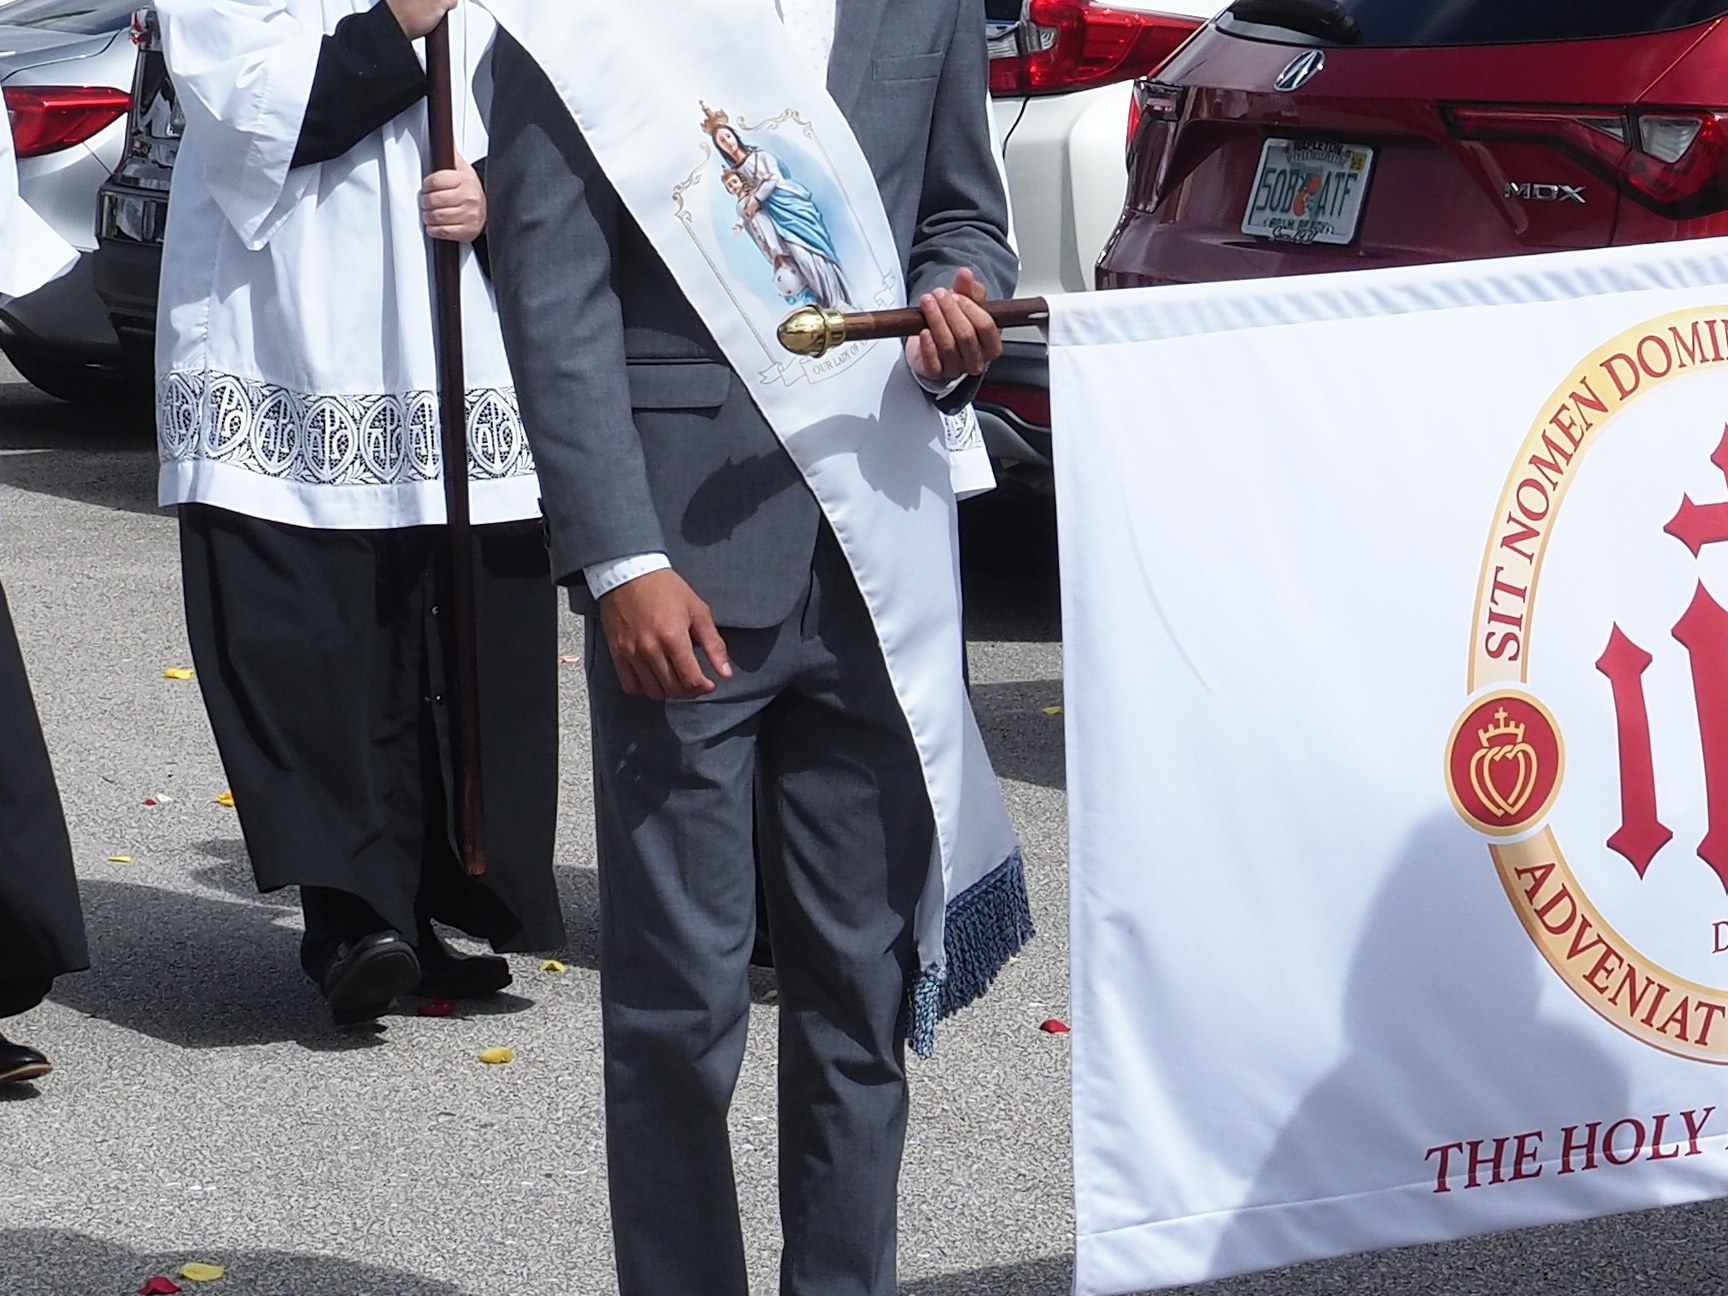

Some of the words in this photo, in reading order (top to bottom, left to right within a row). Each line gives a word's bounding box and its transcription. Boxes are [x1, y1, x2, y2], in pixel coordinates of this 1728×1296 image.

[1504, 182, 1586, 204] MDX
[813, 360, 834, 375] OUR
[1499, 375, 1609, 565] NOMEN
[1484, 565, 1528, 662] SIT
[1514, 862, 1726, 1046] ADVENIAT
[1424, 1130, 1544, 1194] THE
[1557, 1106, 1716, 1175] HOLY
